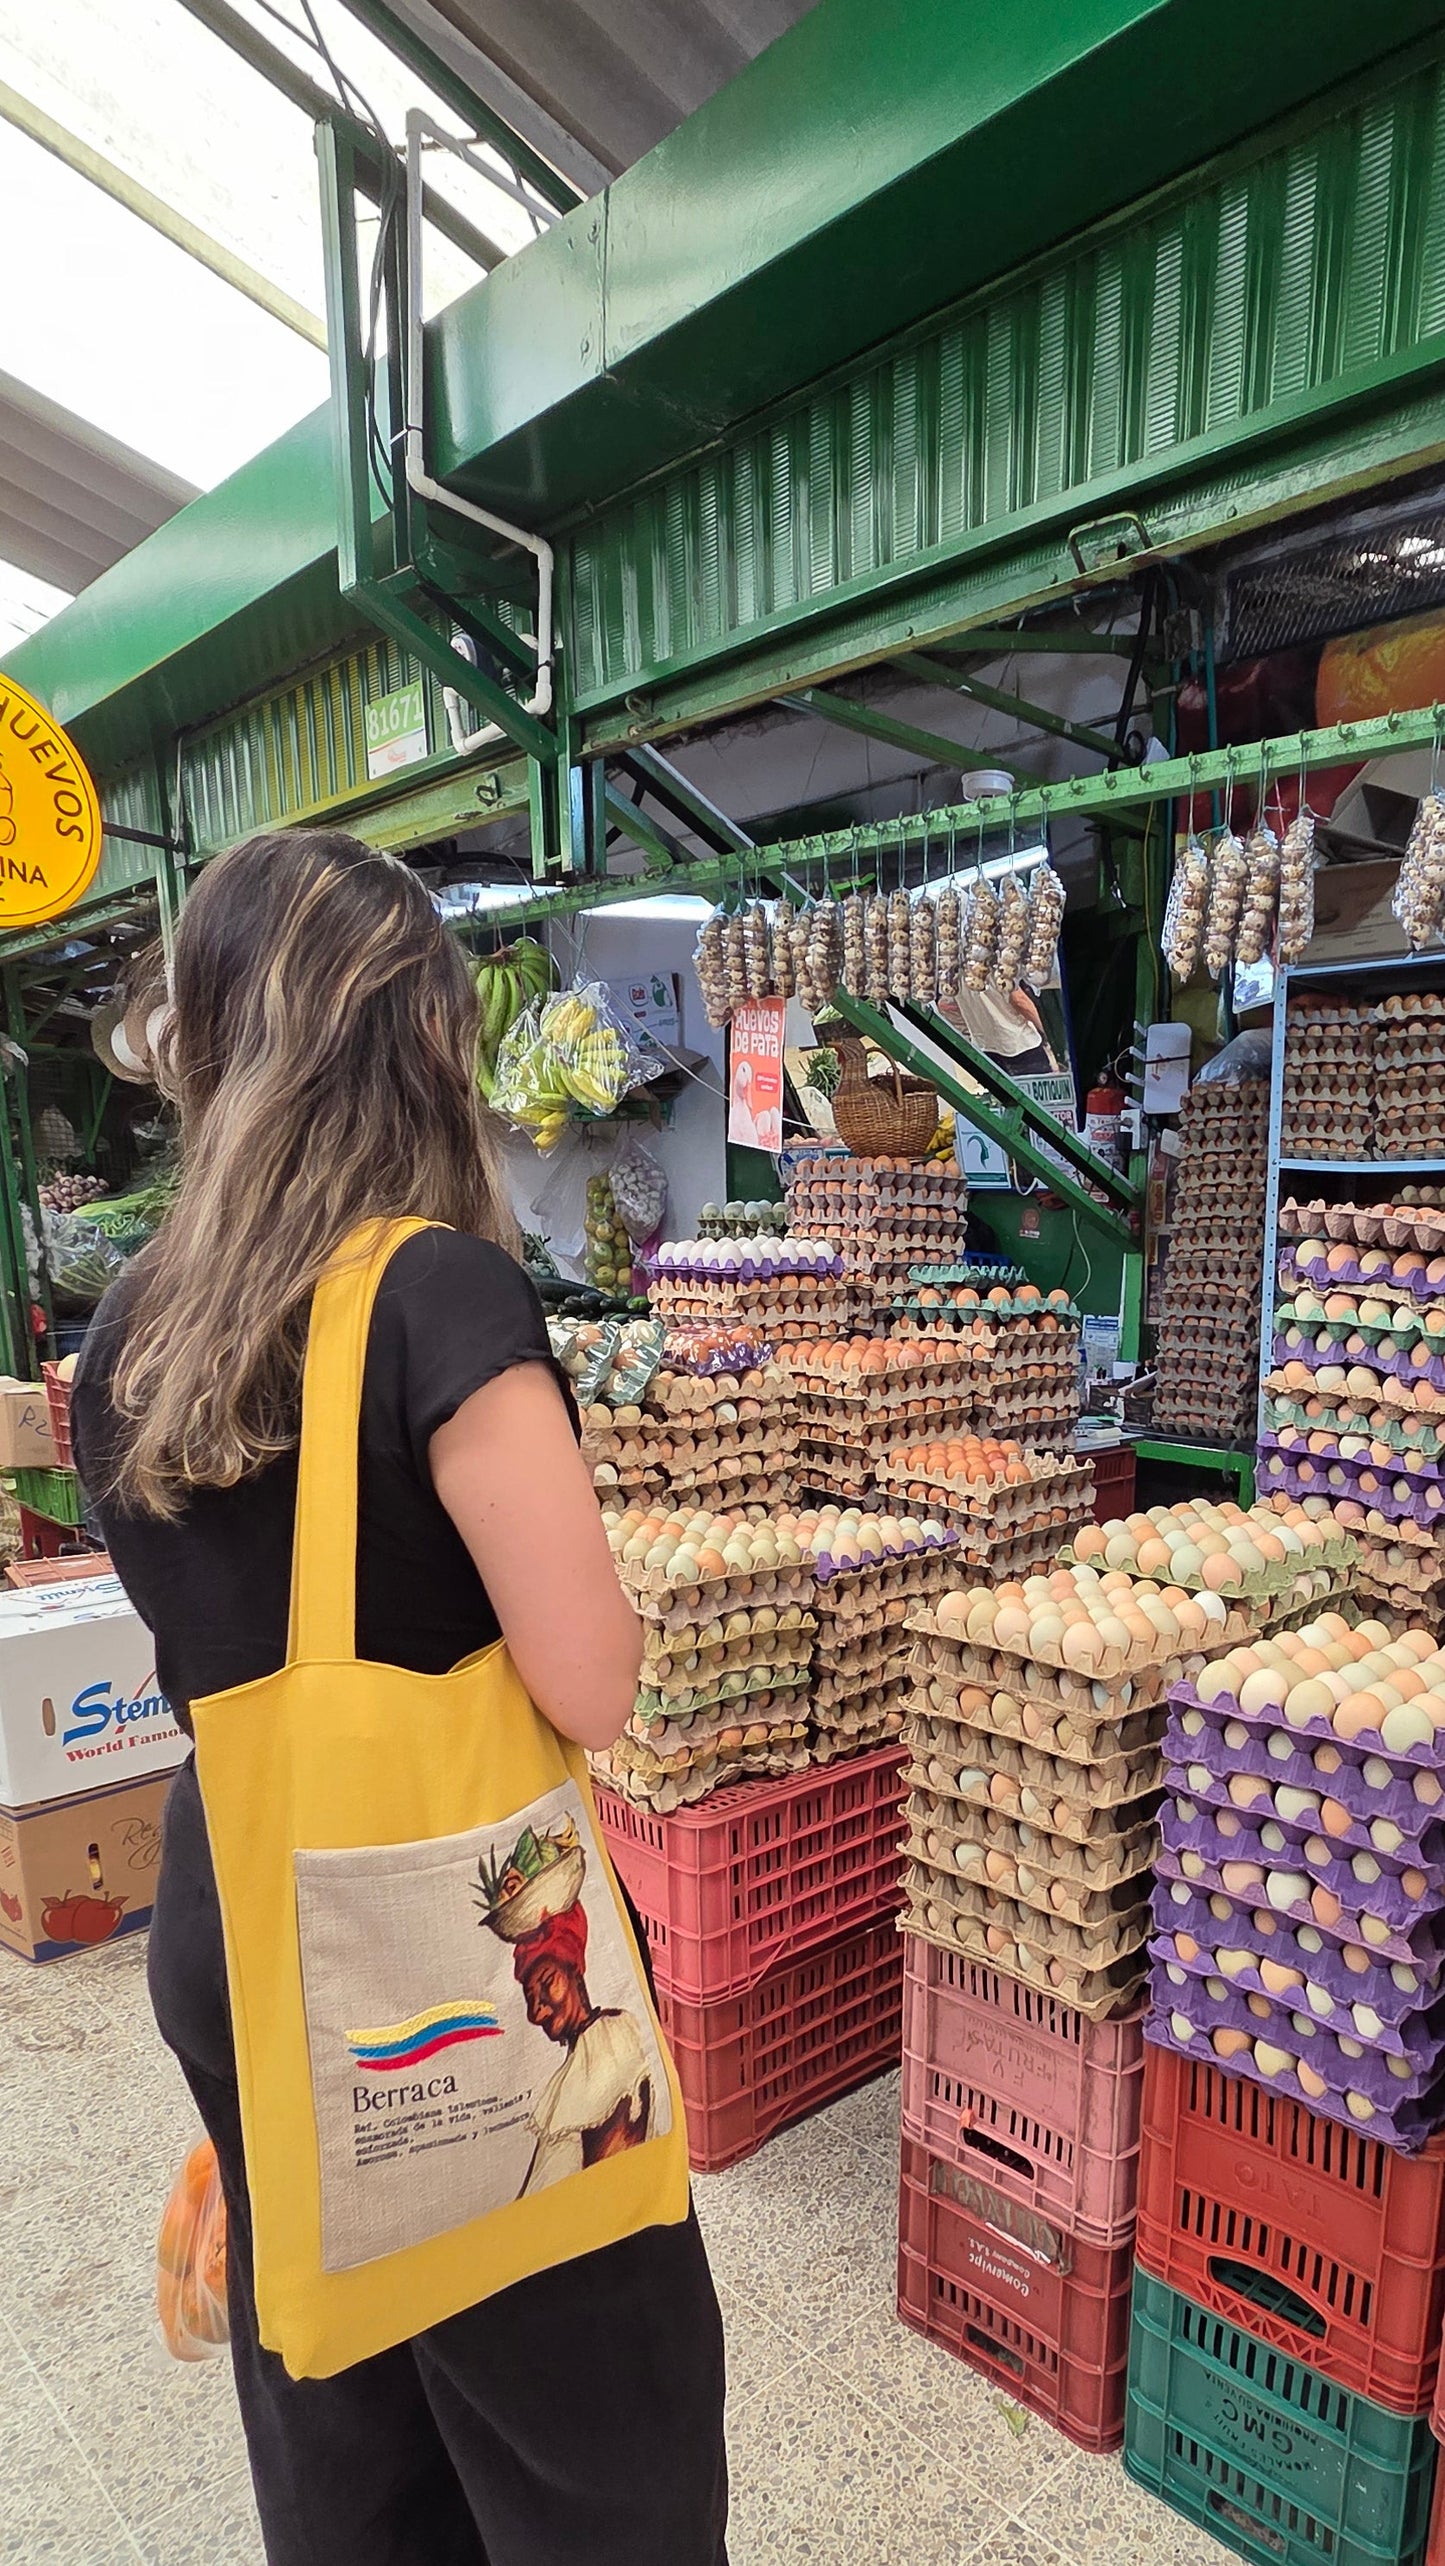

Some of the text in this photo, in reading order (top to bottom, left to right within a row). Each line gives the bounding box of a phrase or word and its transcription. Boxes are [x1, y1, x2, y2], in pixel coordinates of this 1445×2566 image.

[369, 691, 423, 741] 81671
[0, 855, 49, 889] INA
[63, 1681, 172, 1747] Stem
[66, 1737, 123, 1763] World
[353, 2075, 459, 2113] Berraca
[1221, 2397, 1293, 2456] GMC
